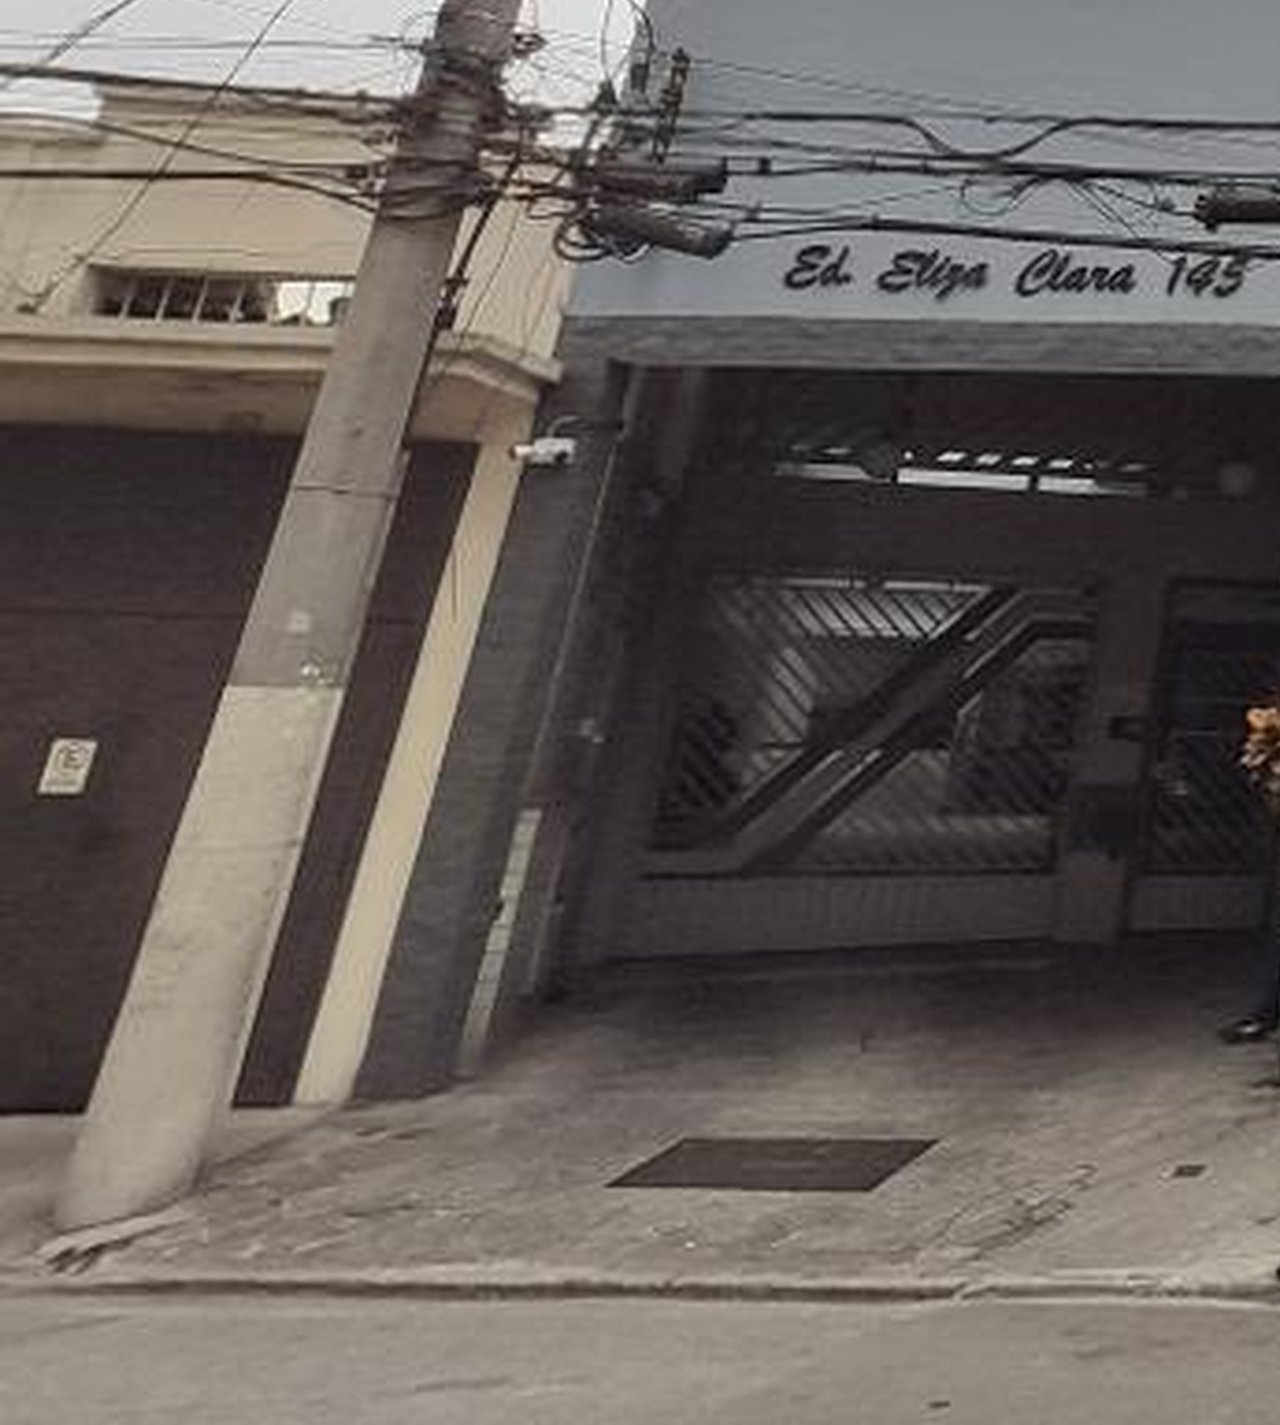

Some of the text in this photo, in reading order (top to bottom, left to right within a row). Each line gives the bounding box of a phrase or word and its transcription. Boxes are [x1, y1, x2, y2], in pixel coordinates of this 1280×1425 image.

[783, 244, 852, 290] Ed.
[1014, 249, 1137, 298] Clara
[1163, 252, 1248, 298] 145
